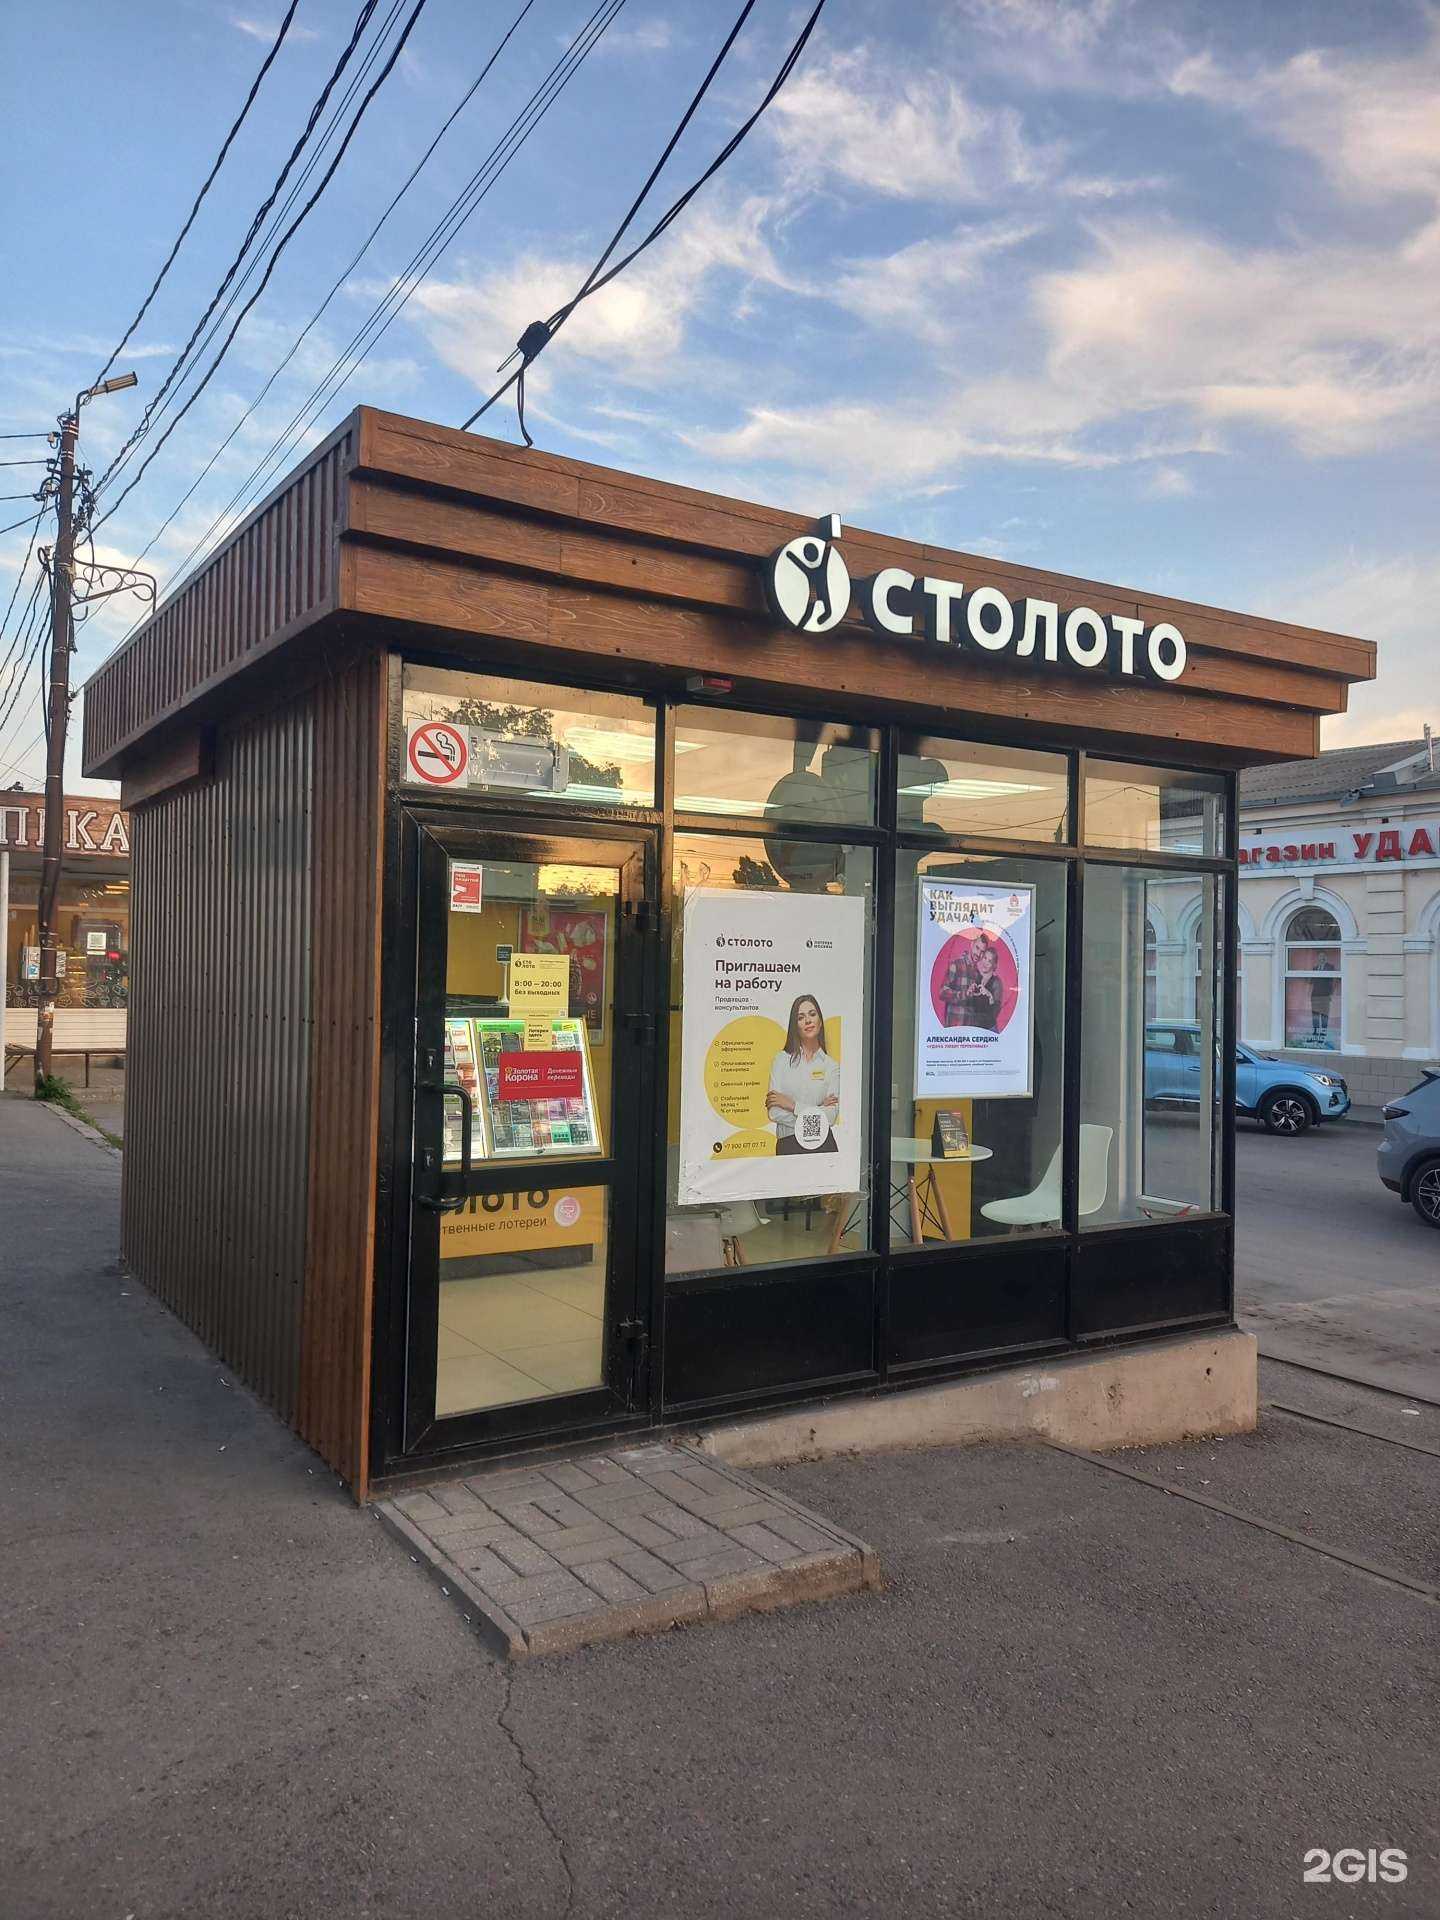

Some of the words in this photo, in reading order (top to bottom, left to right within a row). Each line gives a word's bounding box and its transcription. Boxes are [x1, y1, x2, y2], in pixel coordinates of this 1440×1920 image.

[871, 567, 1188, 682] СТОЛОТО
[1352, 826, 1440, 863] УДА
[929, 889, 954, 901] КАК
[715, 959, 801, 974] Приглашаем
[540, 980, 562, 988] 20:00
[715, 979, 731, 989] на
[735, 976, 783, 992] работу
[505, 1073, 539, 1083] Корона
[442, 1222, 495, 1235] твенные
[498, 1216, 547, 1231] лотереи
